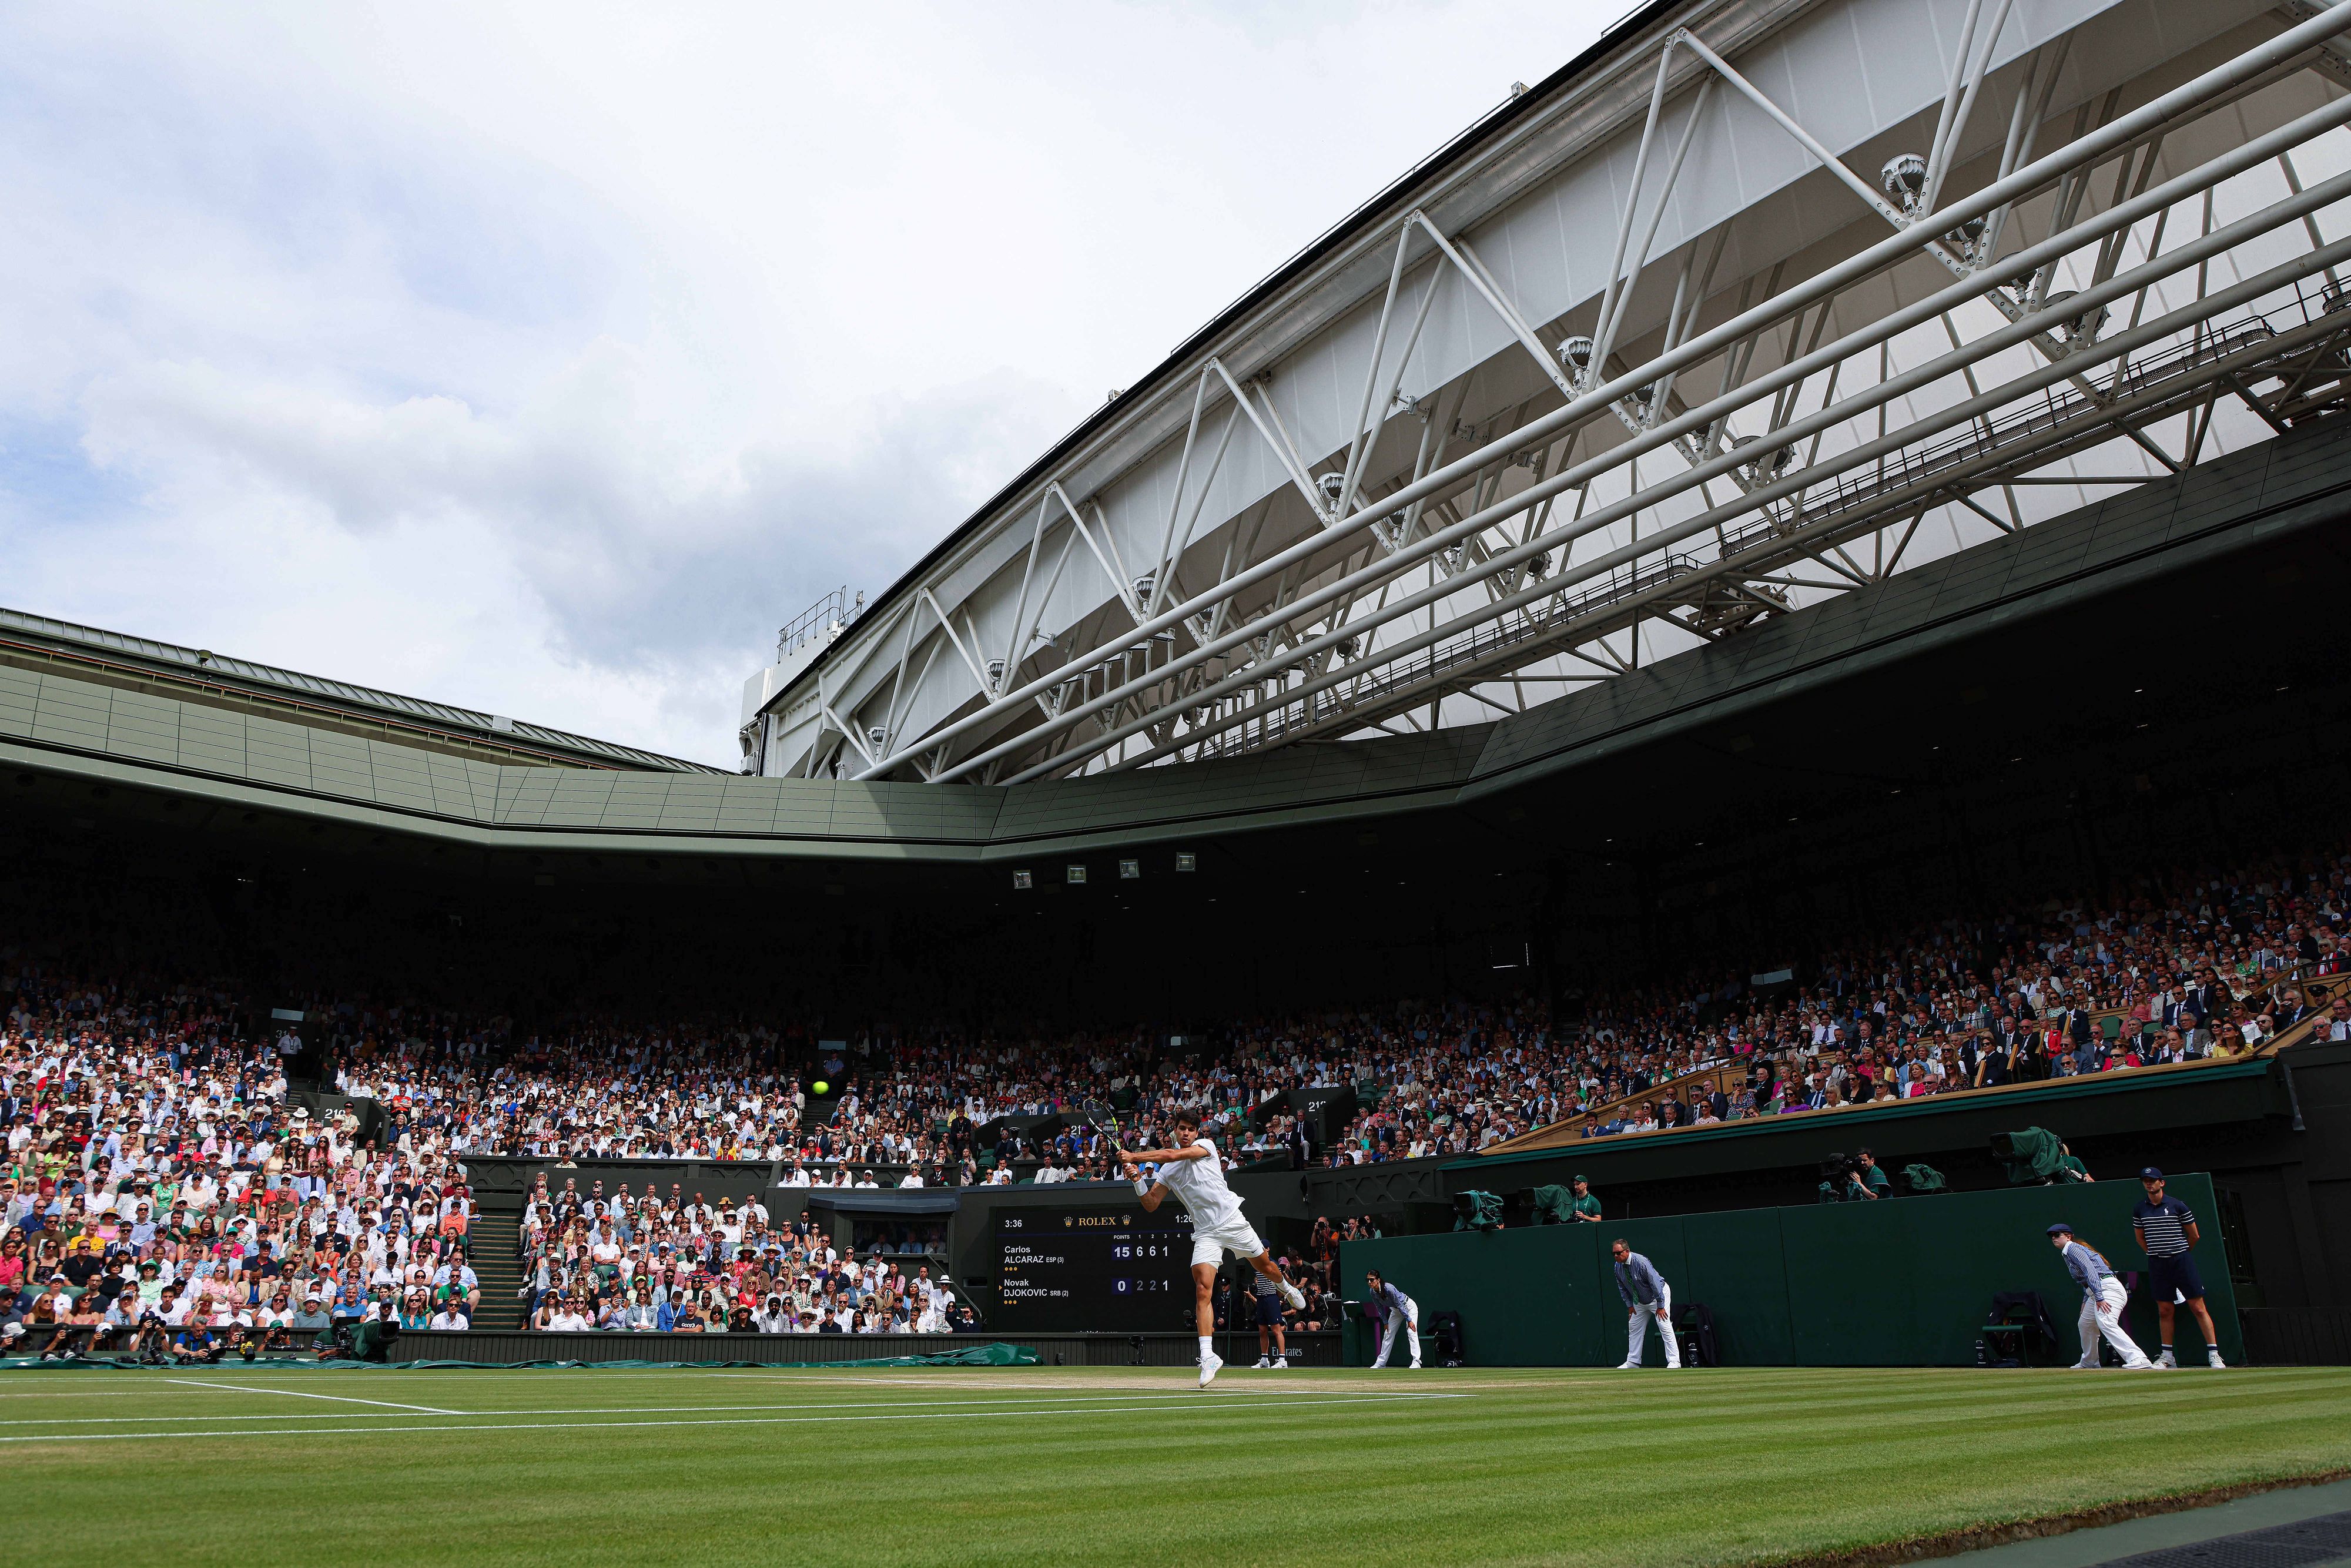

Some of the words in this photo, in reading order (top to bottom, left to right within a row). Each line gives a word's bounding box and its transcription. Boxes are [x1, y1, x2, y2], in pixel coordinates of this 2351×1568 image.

[1308, 1101, 1327, 1112] 21
[1078, 1217, 1116, 1226] ROLEX
[1175, 1214, 1193, 1223] 1:26
[1004, 1219, 1022, 1228] 3:36
[1004, 1245, 1031, 1254] Carlos
[1114, 1247, 1130, 1258] 15
[1136, 1246, 1143, 1257] 6
[1149, 1245, 1156, 1257] 6
[1163, 1245, 1168, 1257] 1
[1004, 1255, 1044, 1264] ALCARAZ
[1117, 1280, 1126, 1292] 0
[1137, 1280, 1143, 1291] 2
[1150, 1280, 1156, 1291] 2
[1163, 1280, 1168, 1291] 1
[1004, 1289, 1047, 1297] DJOKOVIC
[1271, 1346, 1302, 1356] Erates
